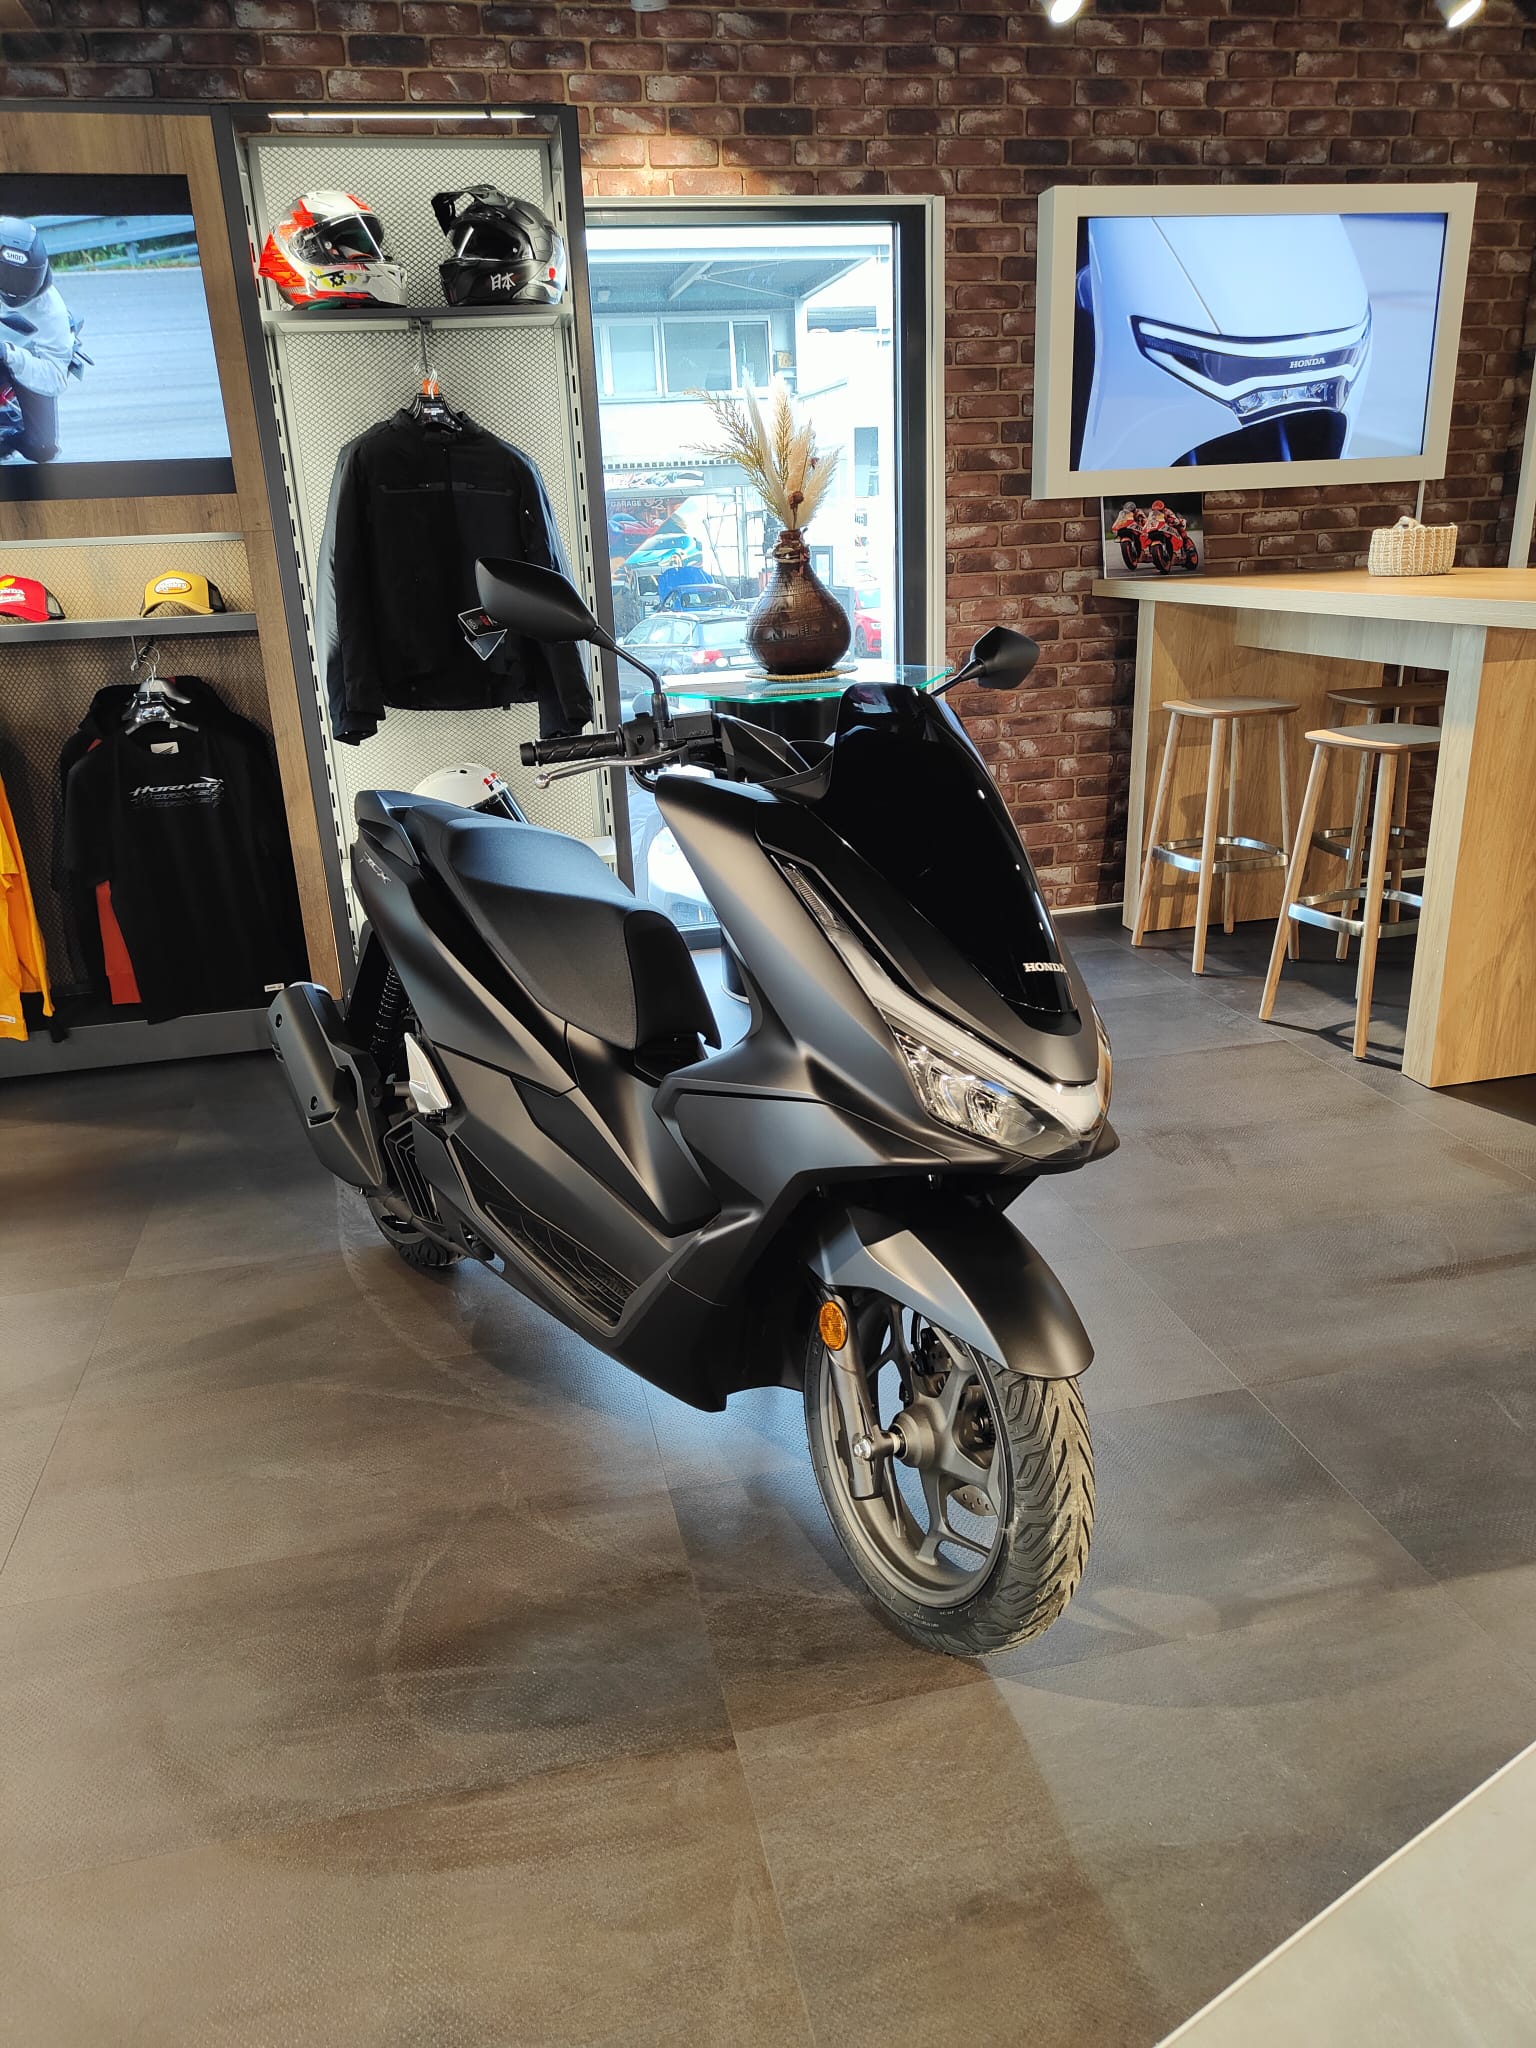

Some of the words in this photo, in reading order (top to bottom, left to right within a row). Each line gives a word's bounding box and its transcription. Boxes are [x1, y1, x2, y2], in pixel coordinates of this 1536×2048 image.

[490, 272, 516, 291] 日本
[1289, 357, 1326, 369] HONDA
[1022, 962, 1068, 973] HONDA
